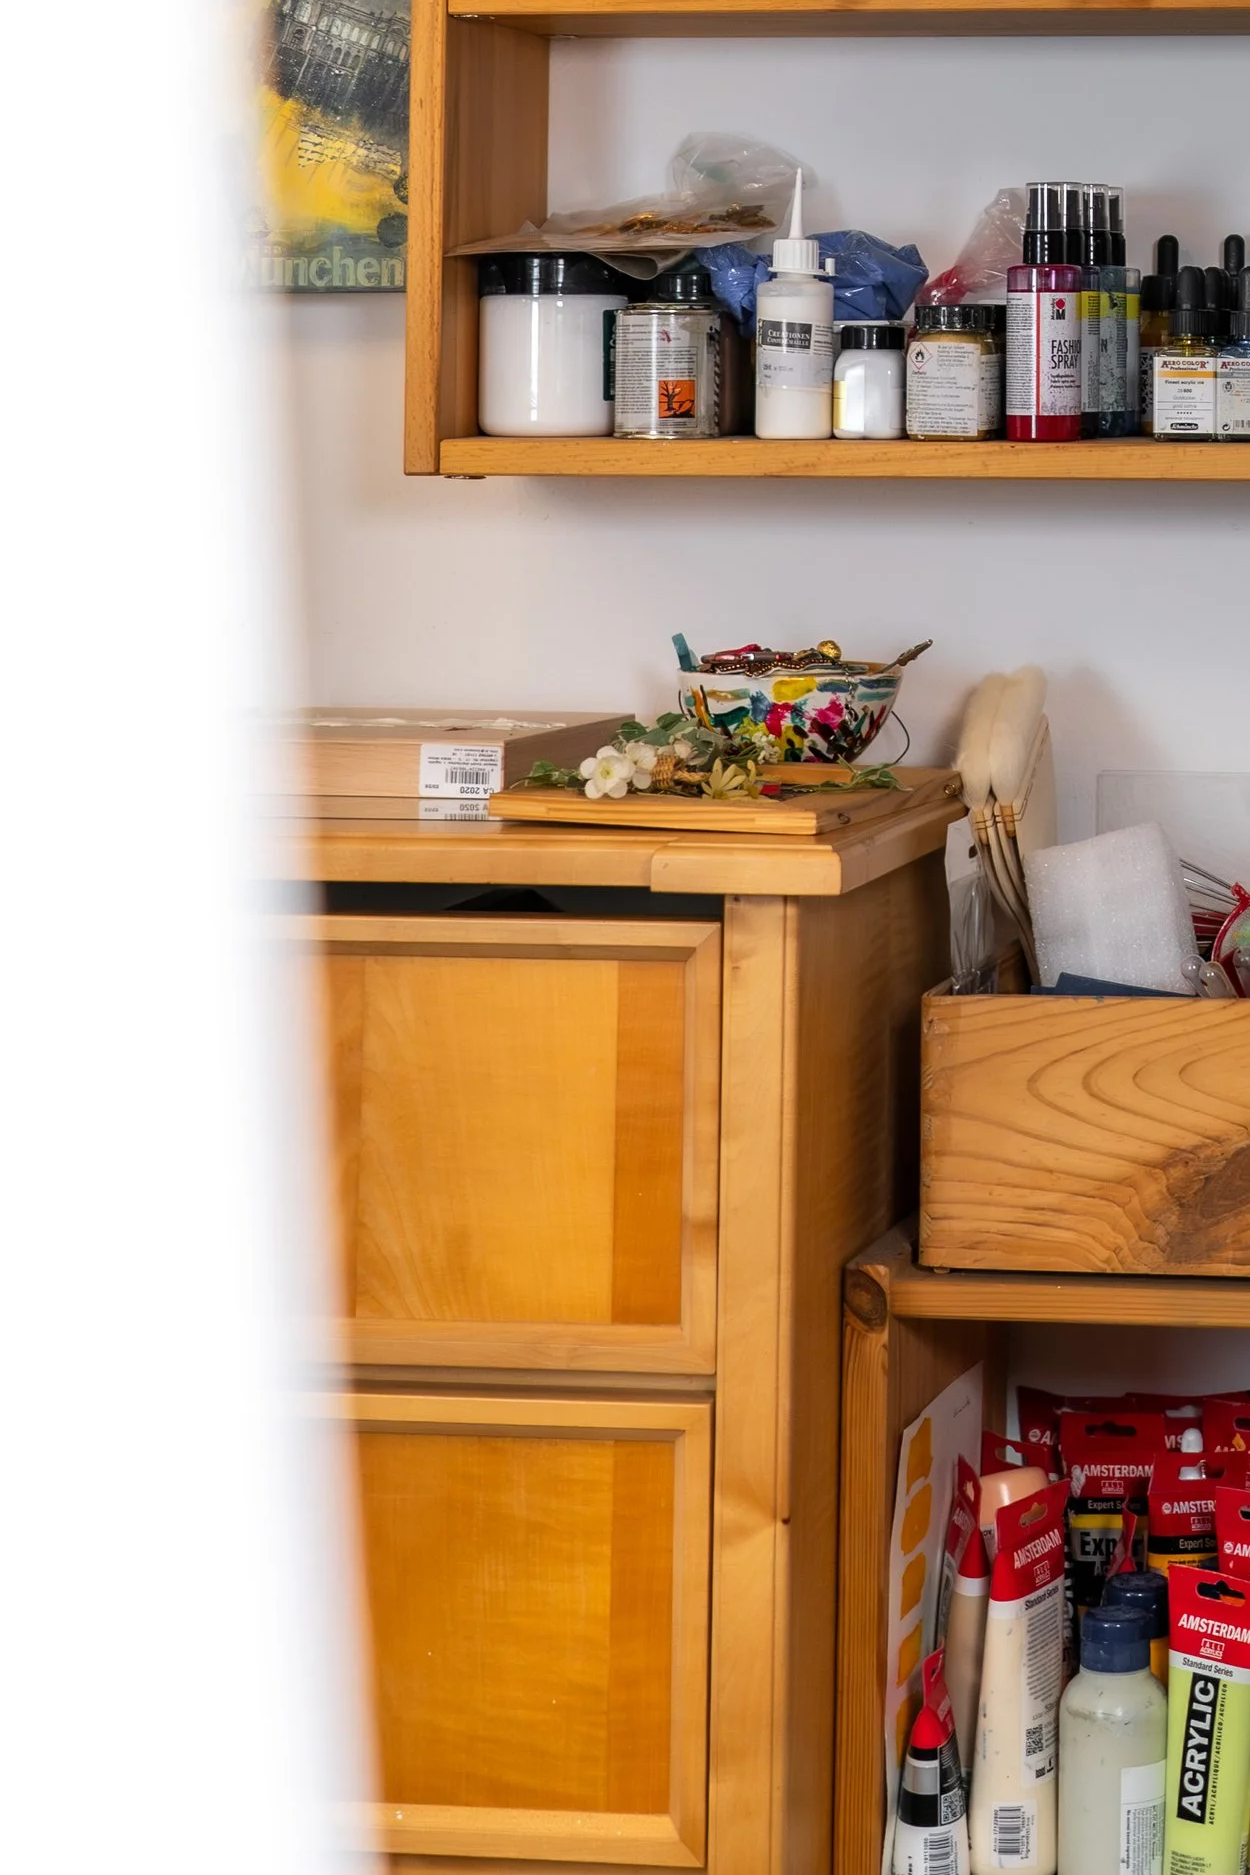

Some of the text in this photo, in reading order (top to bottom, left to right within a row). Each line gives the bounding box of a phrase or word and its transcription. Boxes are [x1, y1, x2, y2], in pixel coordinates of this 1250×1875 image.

[252, 246, 404, 287] ünchen
[1051, 355, 1079, 369] SPRAY
[1083, 1465, 1154, 1478] AMSTERDAM
[1087, 1500, 1115, 1509] Expert
[1172, 1500, 1216, 1513] AMSTER
[1013, 1528, 1062, 1569] AMSTERDAM
[1179, 1539, 1203, 1549] Expert
[1182, 1656, 1234, 1677] Standard Series
[1181, 1679, 1216, 1817] ACRYLIC
